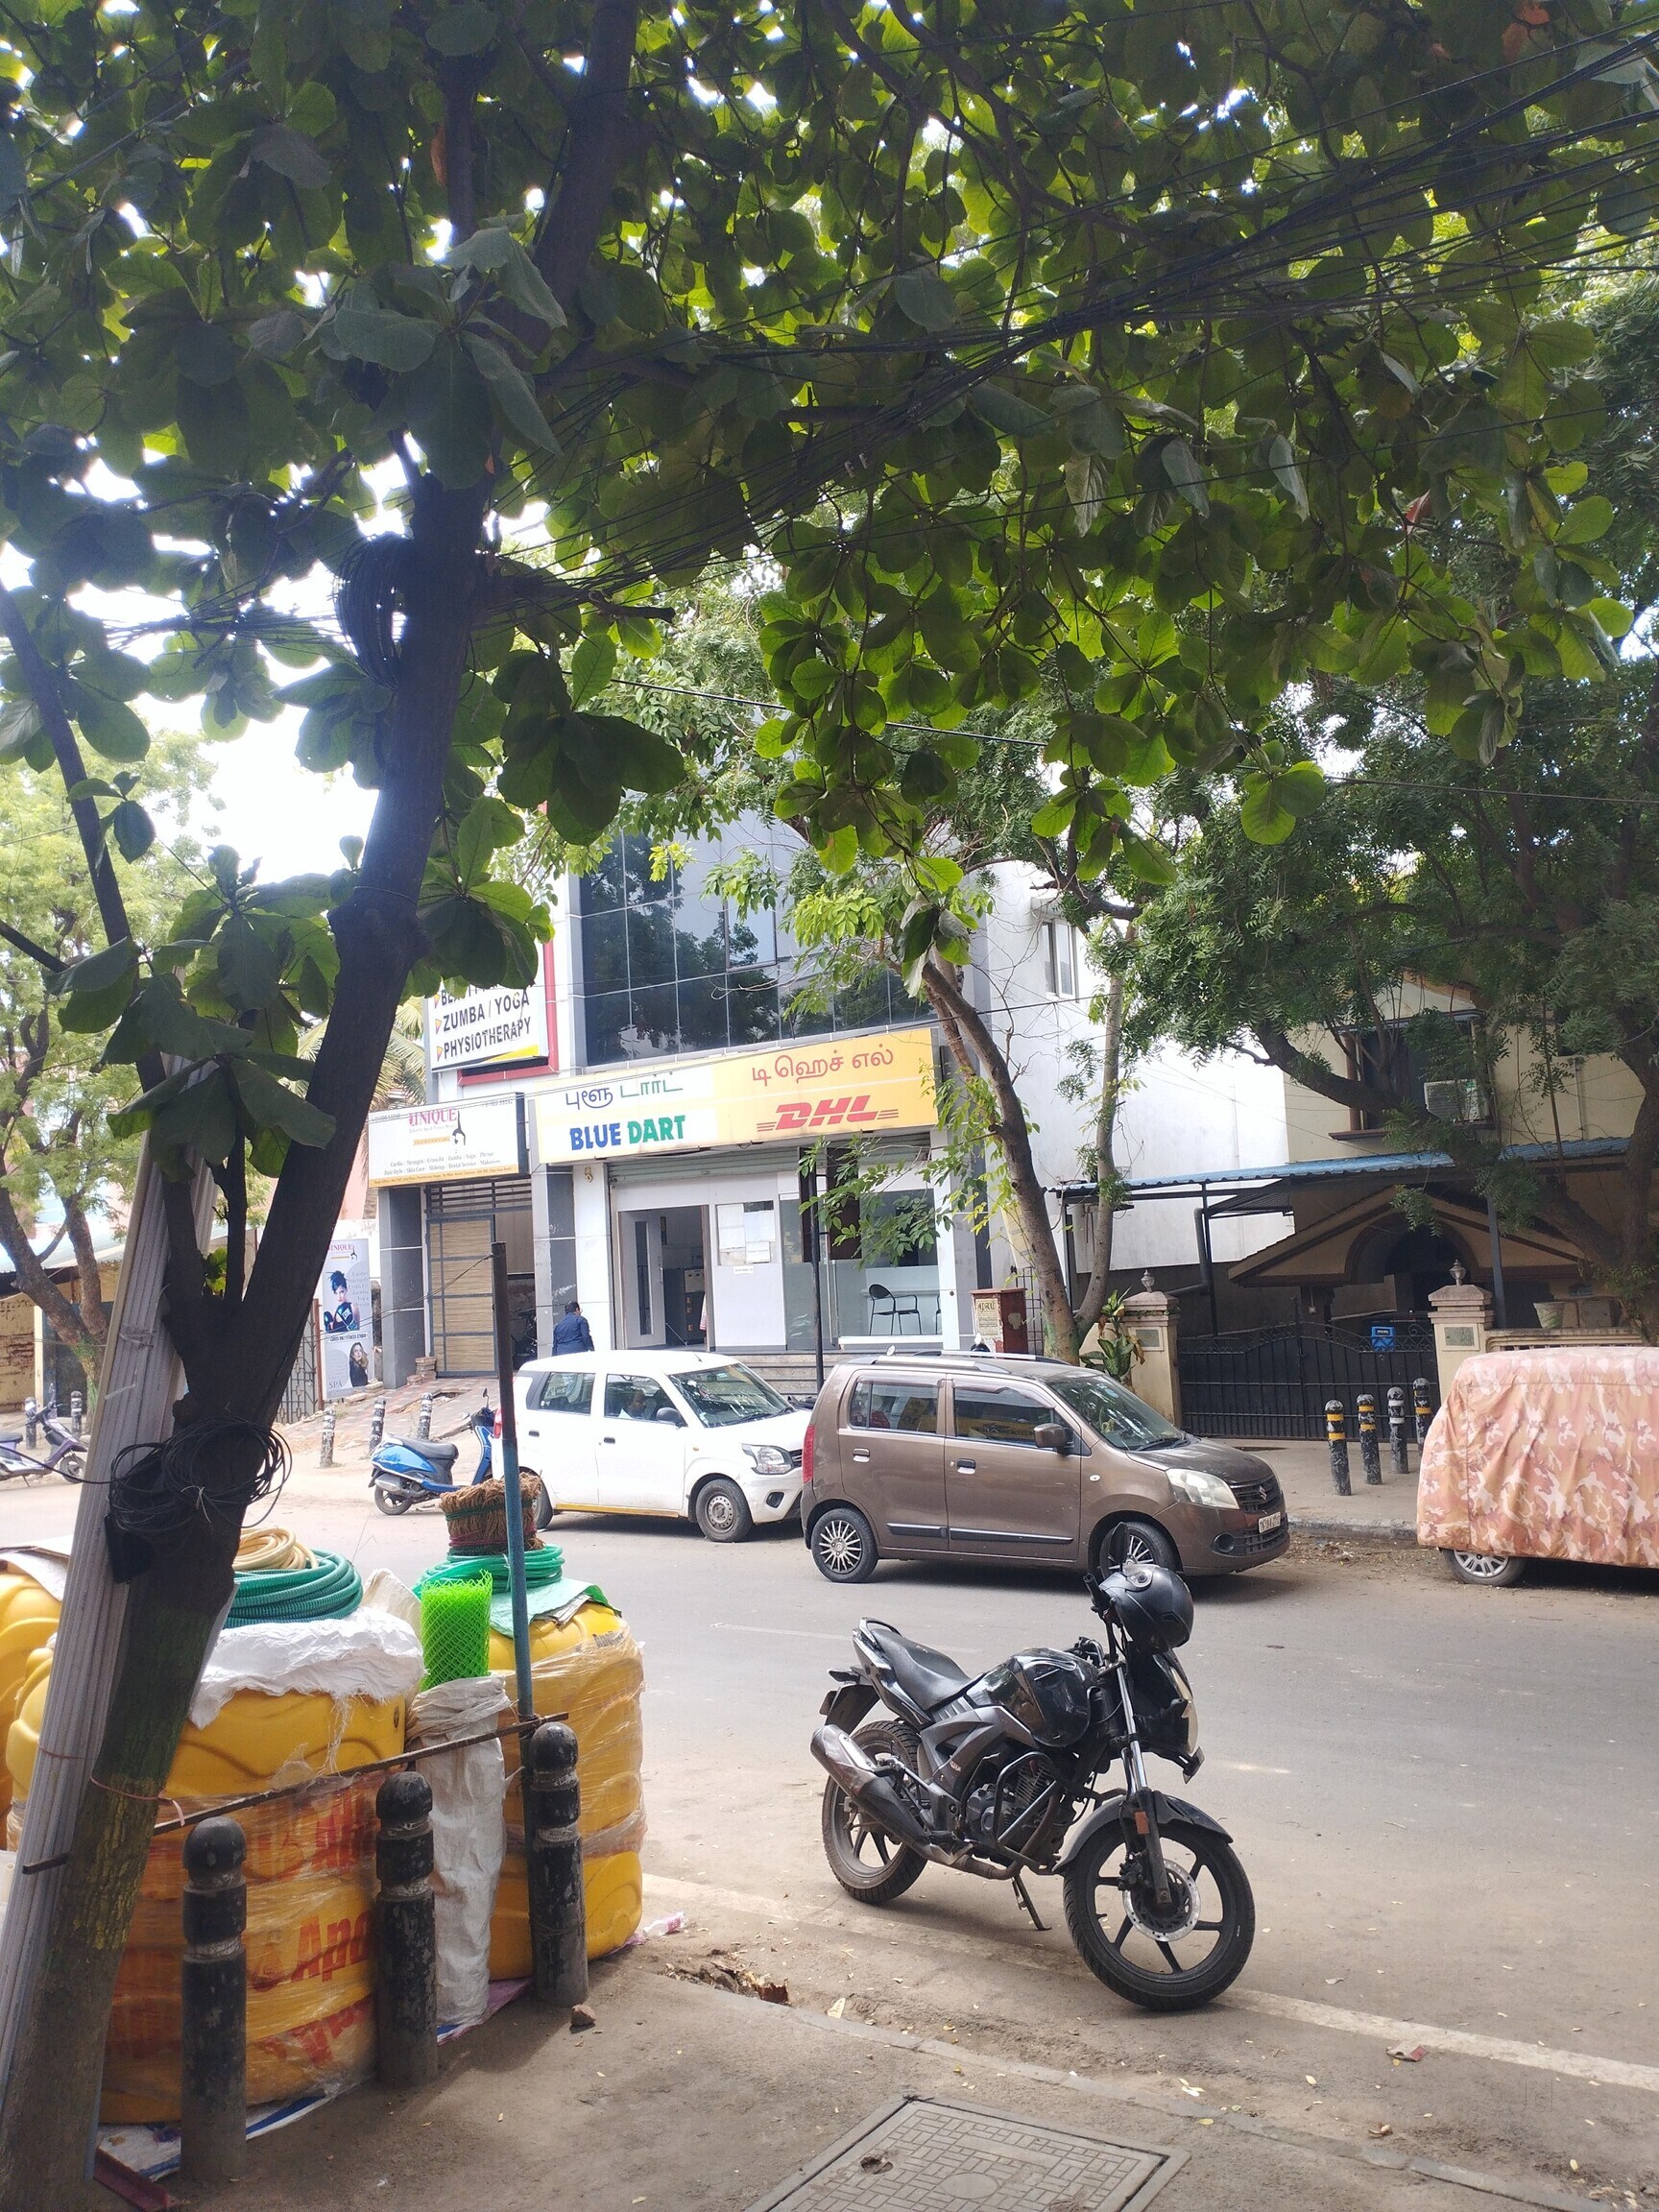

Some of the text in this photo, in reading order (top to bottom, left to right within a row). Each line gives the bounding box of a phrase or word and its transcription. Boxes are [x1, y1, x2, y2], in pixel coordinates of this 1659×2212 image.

[443, 1003, 485, 1032] ZUMBA
[494, 989, 530, 1015] YOGA
[444, 1016, 531, 1059] PHYSIOTHERAPY
[752, 1068, 772, 1087] டி
[852, 1043, 894, 1069] எல்
[408, 1108, 457, 1126] UNIQUE
[569, 1115, 685, 1151] BLUE DART
[775, 1094, 878, 1131] DHL
[291, 1910, 371, 1983] Apo
